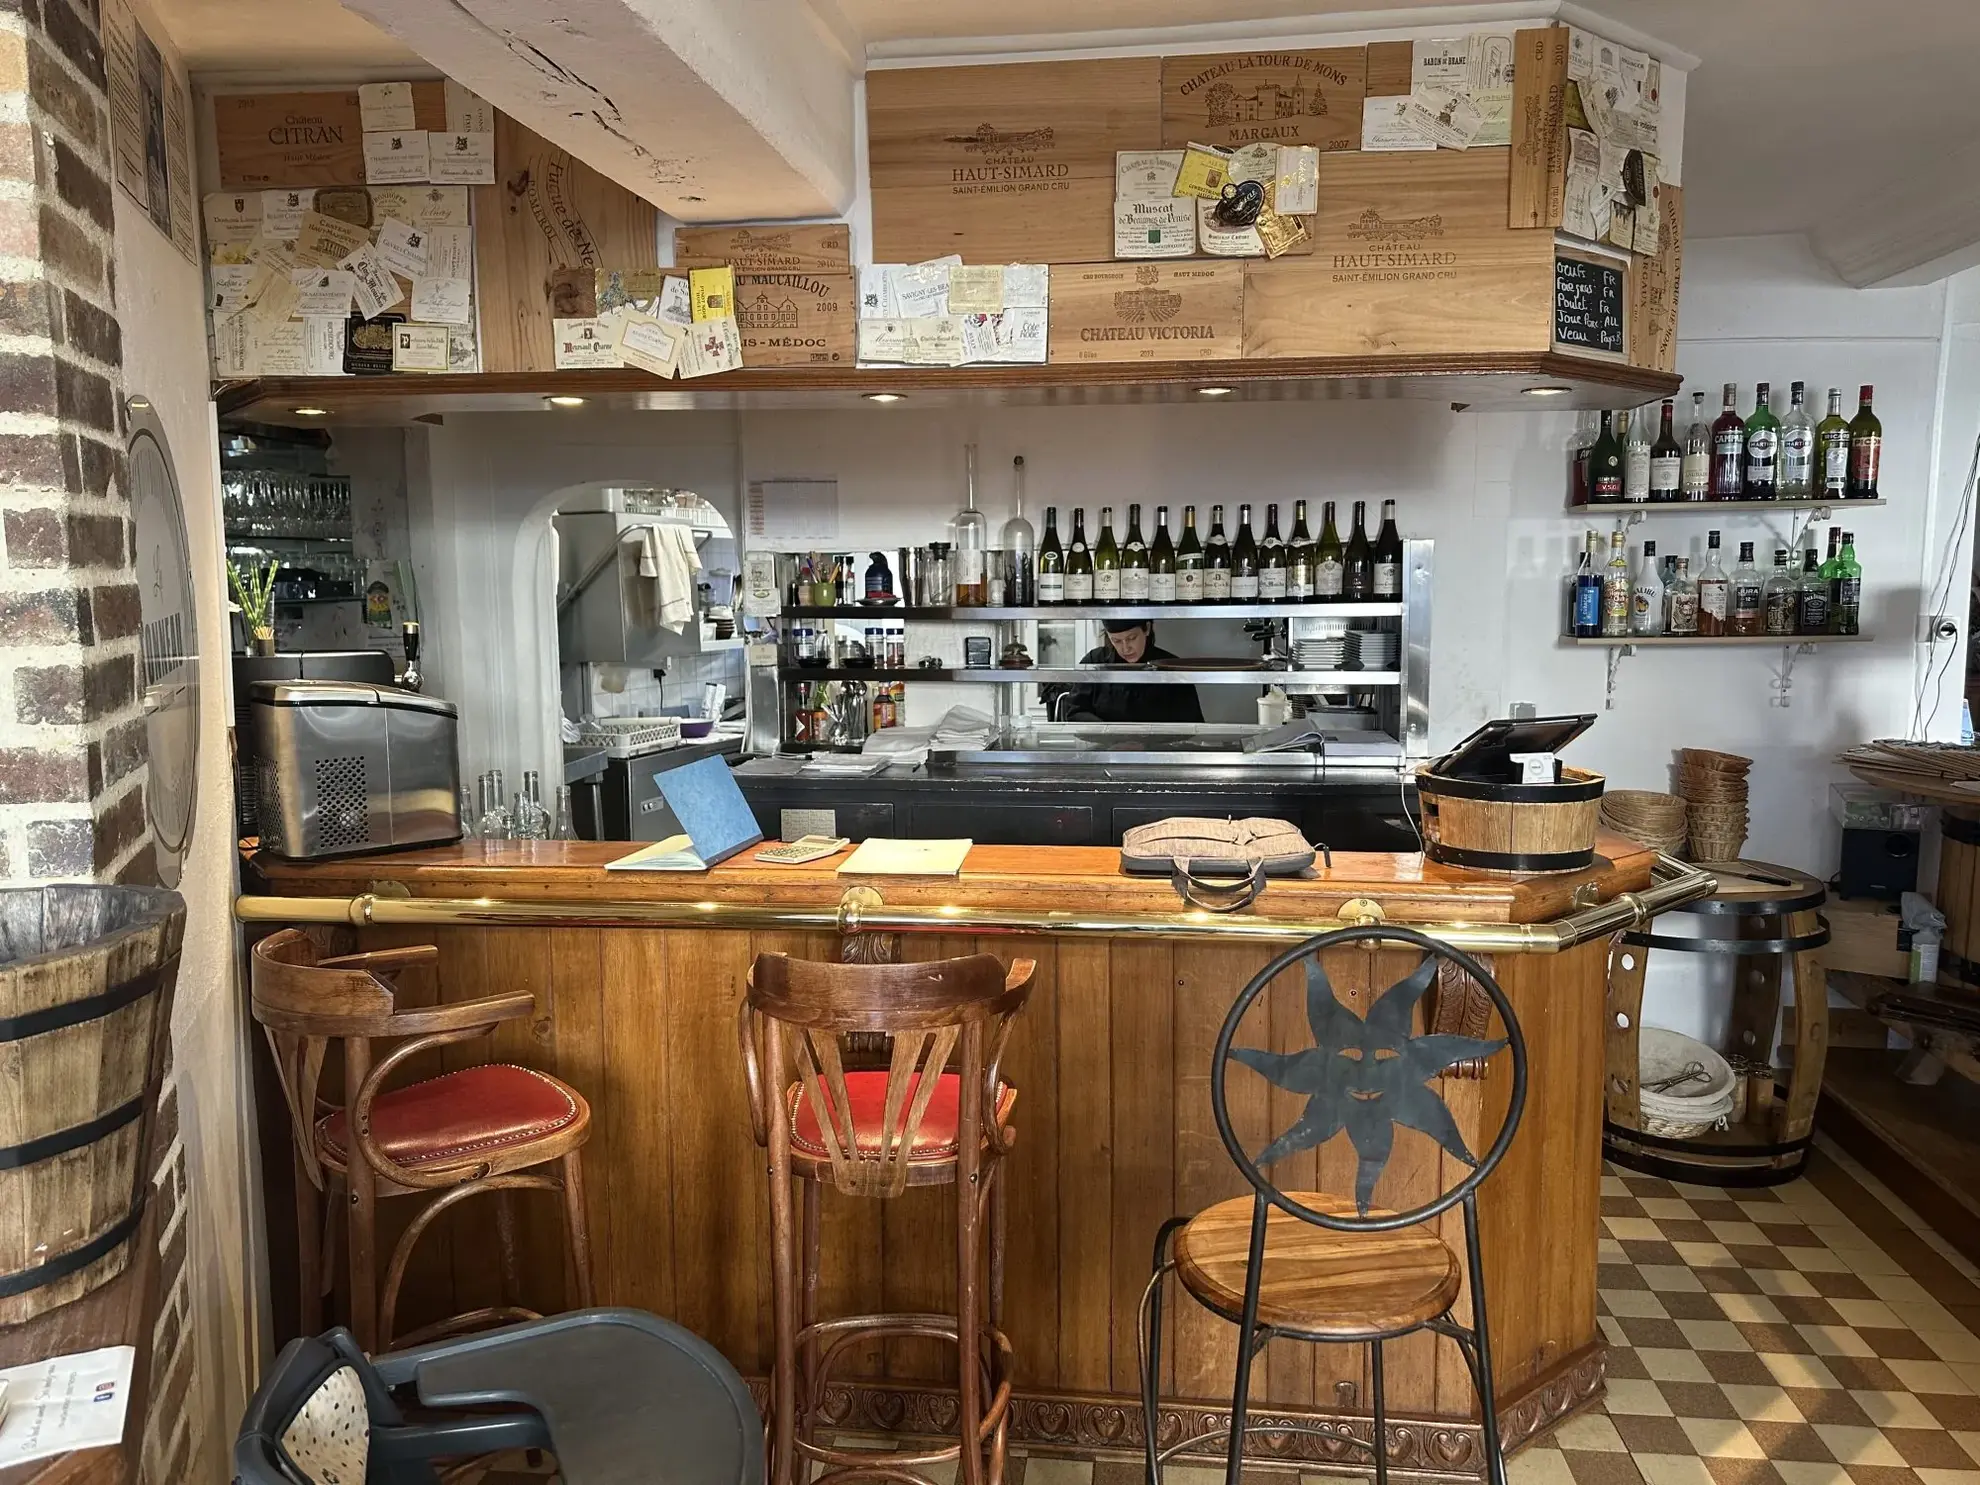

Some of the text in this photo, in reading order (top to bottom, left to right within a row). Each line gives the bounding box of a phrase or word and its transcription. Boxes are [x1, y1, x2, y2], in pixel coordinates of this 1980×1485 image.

[1535, 40, 1544, 61] CRD
[1180, 54, 1348, 96] CHATEAU LA TOUR DE MONS
[268, 125, 344, 145] CITRAN
[1229, 125, 1300, 141] MARGAUX
[1328, 140, 1350, 150] 2007
[985, 156, 1035, 165] CHÂTEAU
[952, 163, 1069, 181] HAUT-SIMARD
[952, 181, 1070, 195] SAINT-ÉMILION GRAND CRU
[527, 180, 557, 240] POMEROL
[1132, 203, 1174, 214] Muscat
[1667, 200, 1681, 253] CHATEAU
[821, 241, 839, 249] CRD
[1368, 243, 1421, 252] CHÂTEAU
[723, 256, 801, 267] HAUT-SIMARD
[1333, 251, 1457, 268] HAUT-SIMARD
[1332, 271, 1457, 283] SAINT-ÉMILION GRAND CRU
[1640, 253, 1649, 308] ARGAUX
[751, 274, 831, 298] MAUCAILLOU
[816, 302, 838, 312] 2009
[1557, 292, 1588, 311] Poulet
[1556, 309, 1582, 325] Joue
[1080, 325, 1215, 342] CHATEAU VICTORIA
[1557, 326, 1591, 342] Veau
[1659, 325, 1674, 356] MONS
[768, 336, 826, 348] MÉDOC
[144, 611, 184, 687] ONNEAU
